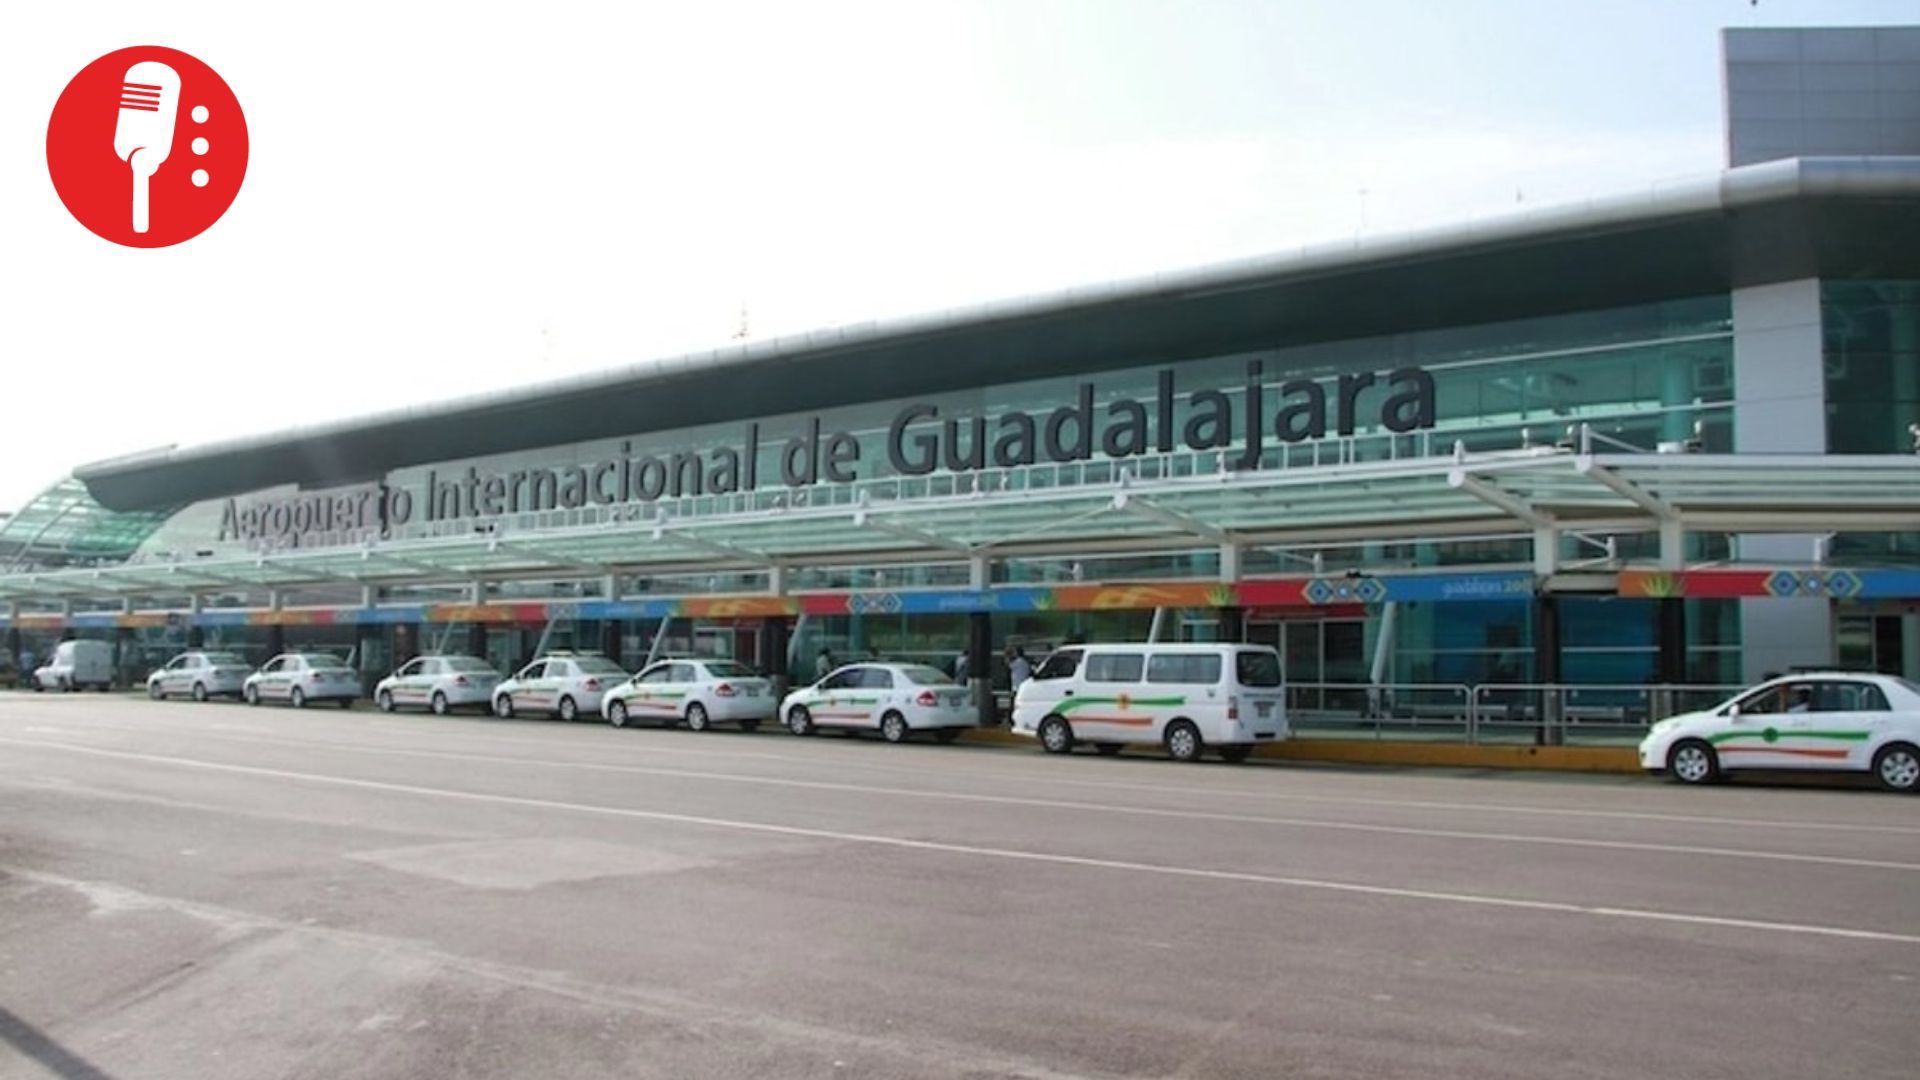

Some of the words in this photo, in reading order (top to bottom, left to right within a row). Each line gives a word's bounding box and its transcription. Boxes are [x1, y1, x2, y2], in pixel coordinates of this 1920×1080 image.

[219, 484, 412, 541] Aeropuerto
[427, 423, 758, 520] Internacional
[781, 418, 860, 486] de
[890, 360, 1436, 471] Guadalajara
